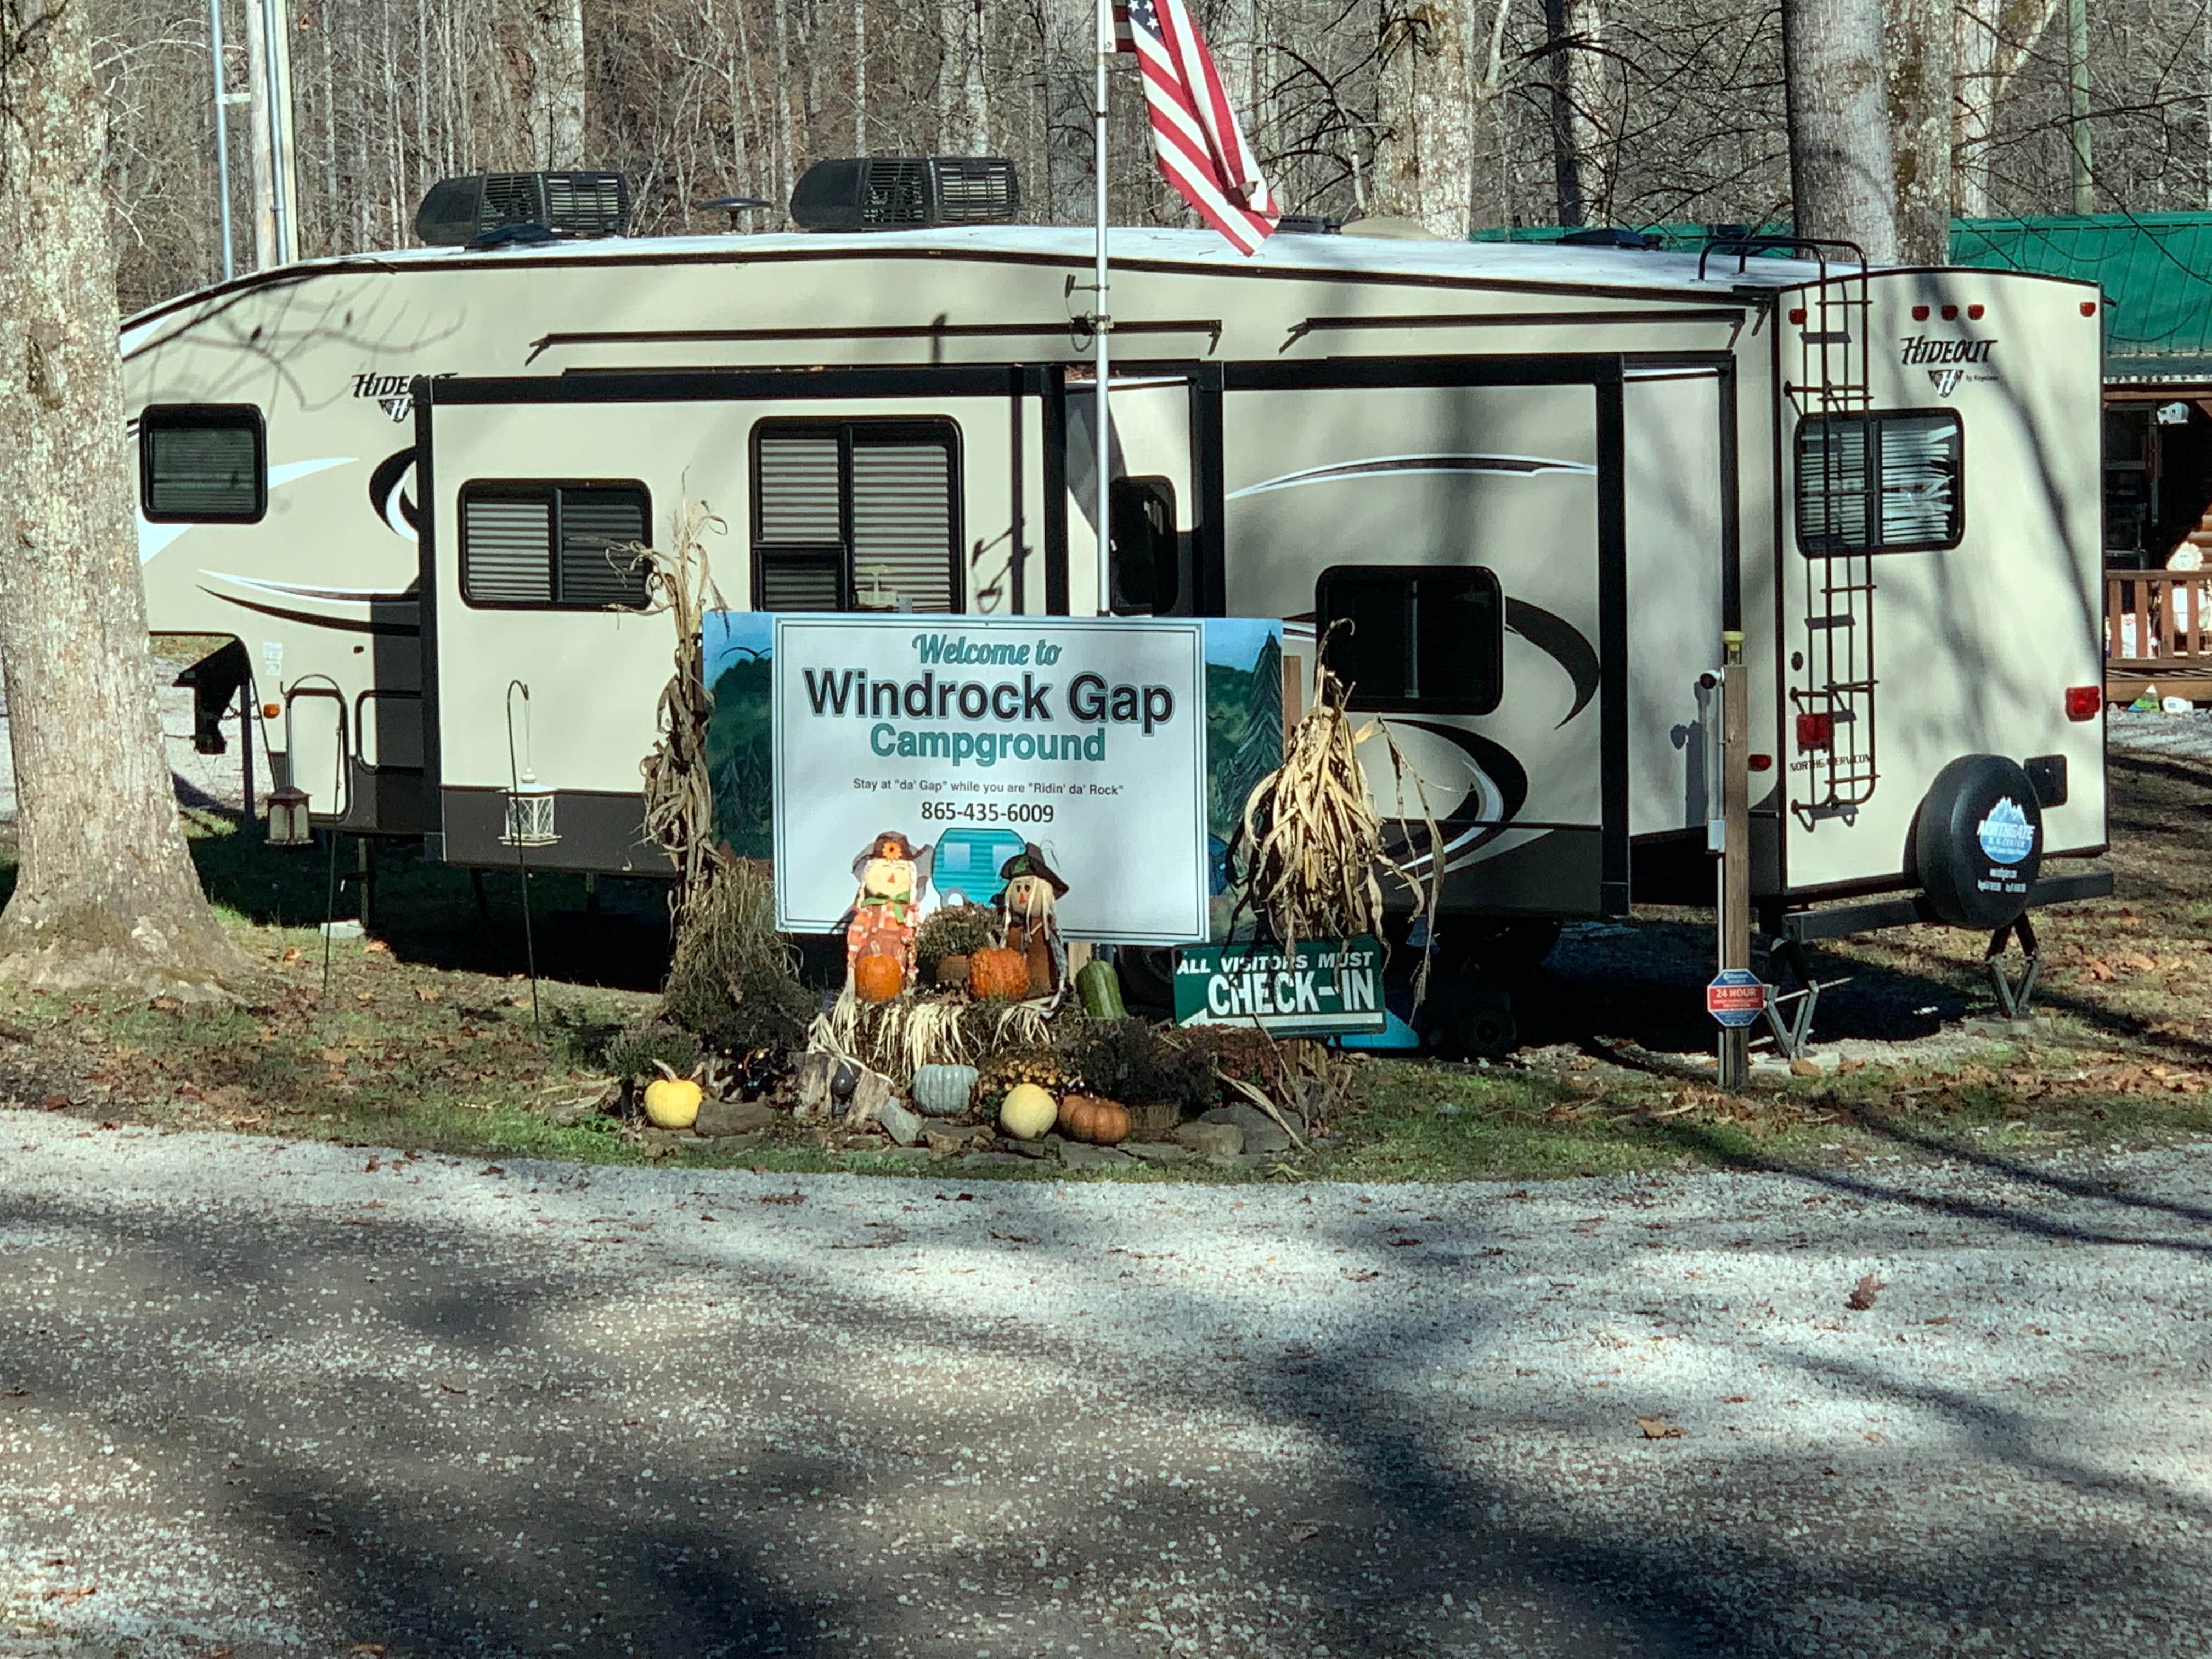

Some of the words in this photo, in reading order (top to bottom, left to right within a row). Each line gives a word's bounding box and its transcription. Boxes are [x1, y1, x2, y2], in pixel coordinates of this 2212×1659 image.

[1900, 335, 1998, 365] HIDEOUT
[352, 371, 458, 398] HIDE
[912, 634, 1030, 665] Welcome
[1035, 639, 1062, 665] to
[802, 668, 1053, 721] Windrock
[1067, 671, 1175, 737] Gap
[870, 723, 1105, 767] Campground
[853, 778, 877, 792] Stay
[881, 780, 891, 789] at
[895, 779, 916, 790] "da'
[919, 780, 947, 793] Gap"
[950, 781, 980, 792] while
[983, 783, 1004, 794] you
[1007, 783, 1025, 793] are
[1028, 782, 1065, 794] "Ridin'
[1069, 783, 1086, 794] da'
[1089, 784, 1124, 795] Rock"
[921, 801, 1054, 823] 865-435-6009
[1177, 959, 1211, 975] ALL
[1221, 954, 1308, 972] VISITORS
[1318, 952, 1373, 968] MUST
[1207, 969, 1375, 1015] CHECK-IN
[1716, 989, 1728, 998] 24
[1729, 988, 1757, 997] HOUR
